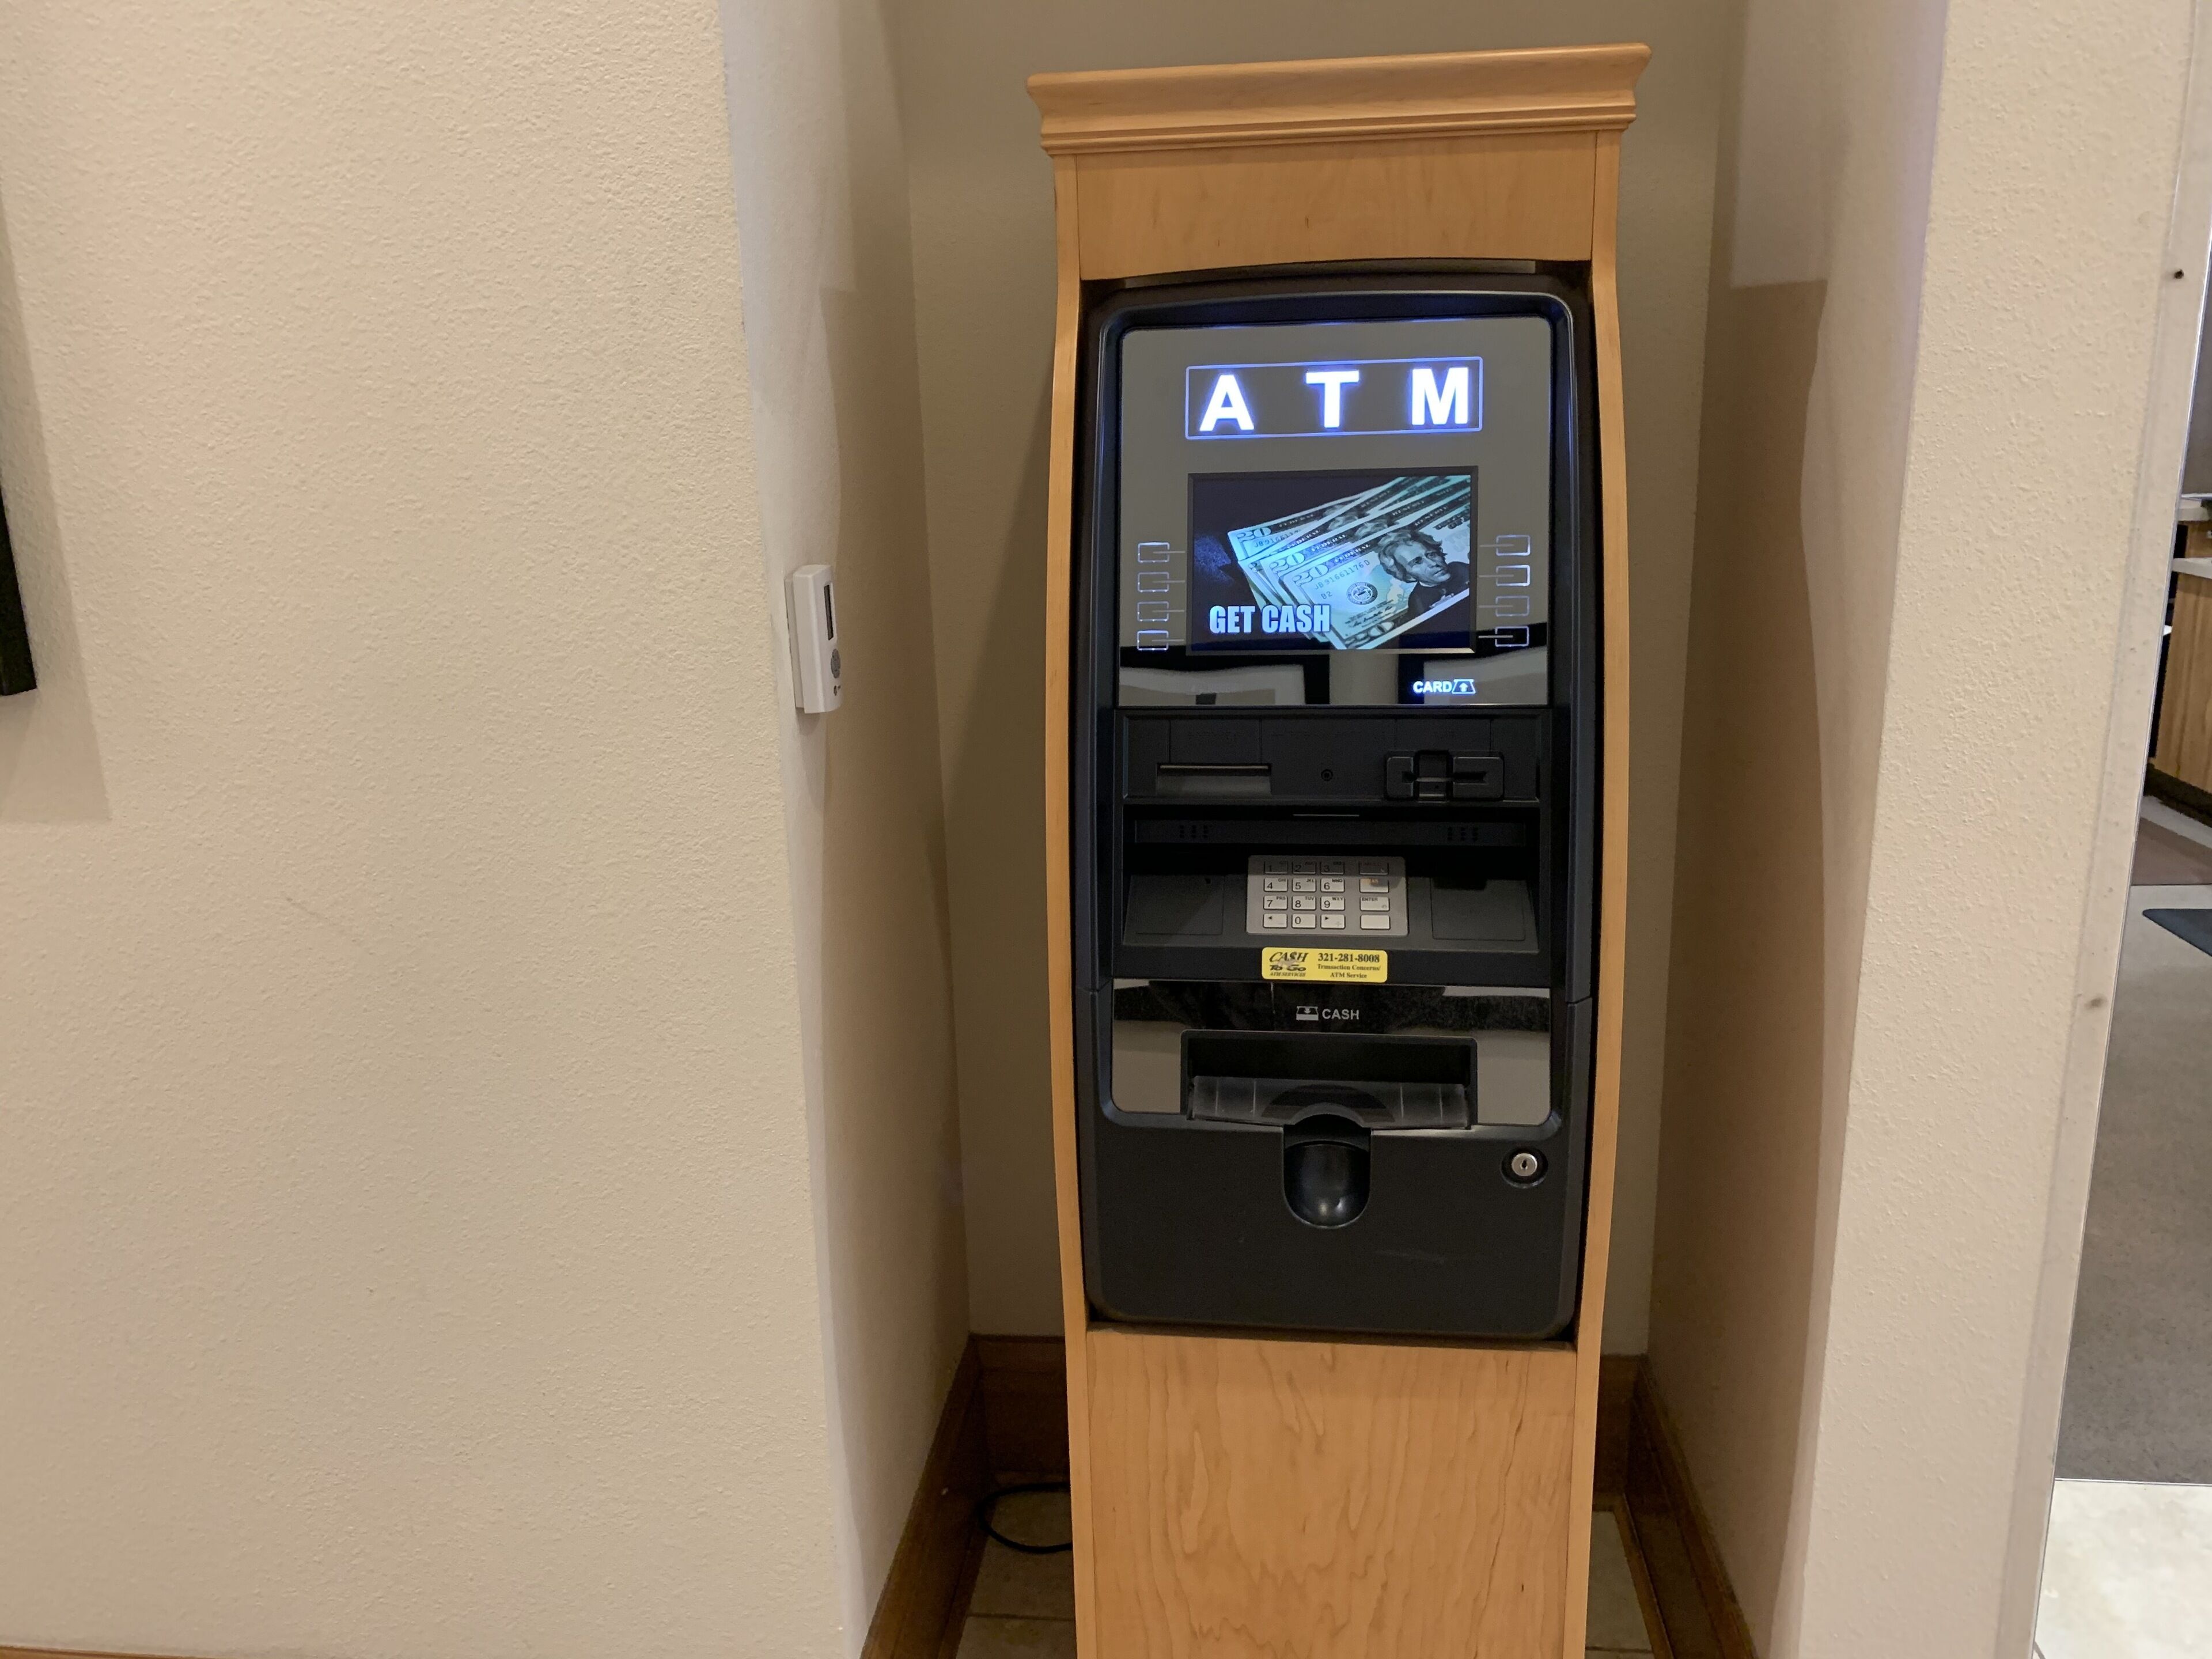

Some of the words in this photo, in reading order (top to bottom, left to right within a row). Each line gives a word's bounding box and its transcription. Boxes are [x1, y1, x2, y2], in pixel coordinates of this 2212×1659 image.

[1210, 605, 1255, 634] GET
[1262, 605, 1330, 633] CASH
[1413, 681, 1452, 694] CARD
[1295, 882, 1302, 890] 5
[1324, 882, 1331, 890] 6
[1295, 900, 1302, 908] 8
[1324, 900, 1331, 908] 9
[1294, 916, 1301, 925] 0
[1317, 952, 1380, 963] 321-281-8008
[1321, 1009, 1359, 1020] CASH
